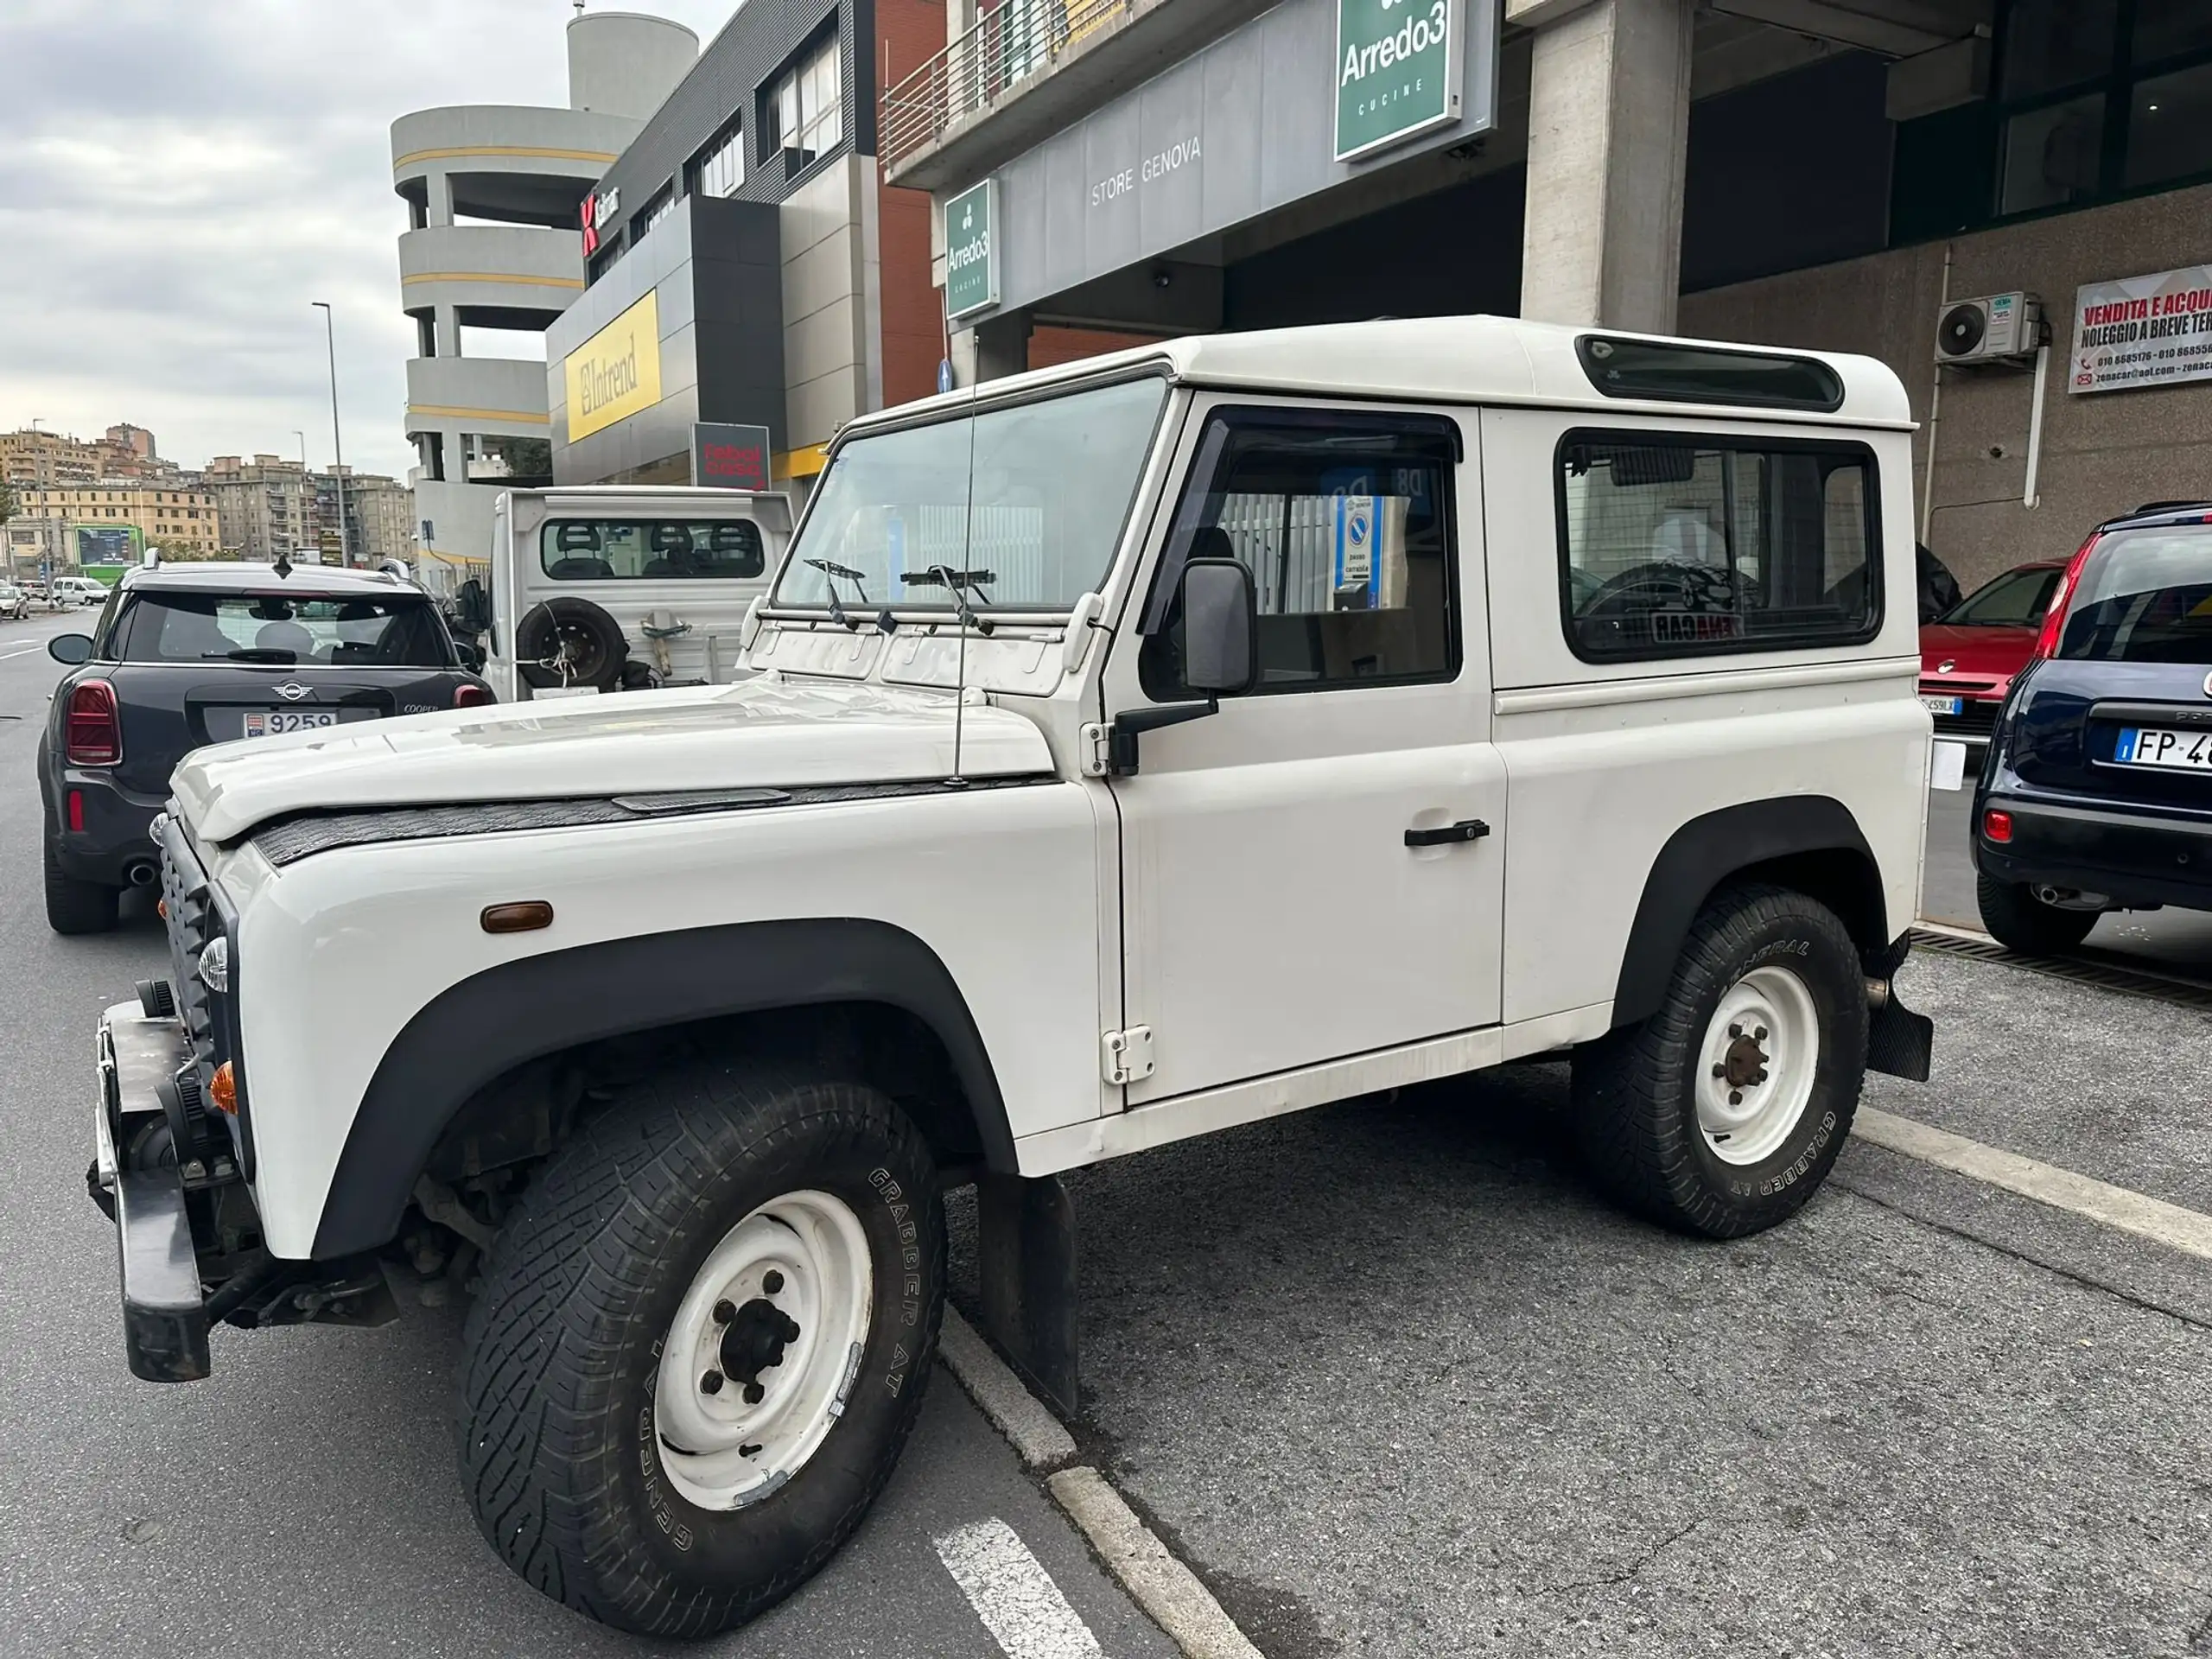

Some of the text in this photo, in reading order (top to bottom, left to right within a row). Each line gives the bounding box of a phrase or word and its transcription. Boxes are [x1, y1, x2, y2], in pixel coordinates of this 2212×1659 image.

[1341, 1, 1446, 87] Arredo3
[1358, 79, 1422, 116] CUCINE
[1092, 136, 1201, 207] STORE GENOVA
[948, 230, 988, 274] Arredo3
[2084, 289, 2212, 327] VENDITA E ACQU
[2082, 321, 2138, 348] NOLEGGIO
[2139, 321, 2148, 340] A
[2150, 315, 2190, 340] BREVE
[591, 329, 639, 411] Intrend
[2097, 357, 2113, 366] 010
[2158, 348, 2176, 359] 010
[270, 715, 331, 734] 9259
[2137, 731, 2177, 761] FP
[2186, 734, 2212, 765] 4
[1760, 1111, 1837, 1196] GRABBER
[868, 1167, 920, 1327] GRABBER
[885, 1342, 910, 1399] AT
